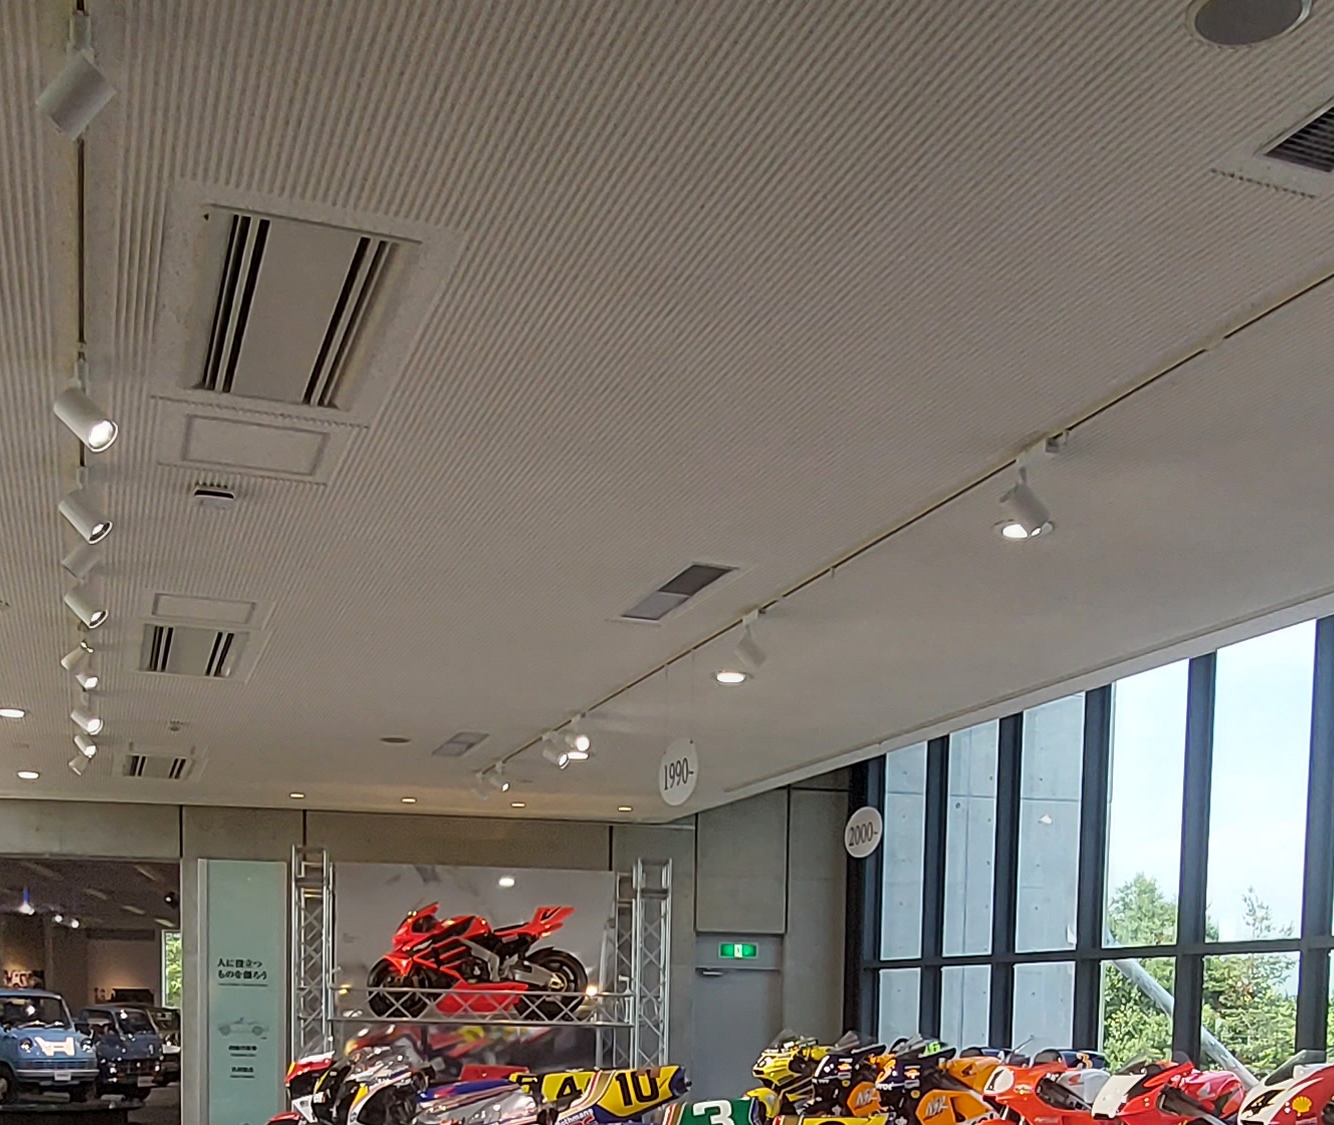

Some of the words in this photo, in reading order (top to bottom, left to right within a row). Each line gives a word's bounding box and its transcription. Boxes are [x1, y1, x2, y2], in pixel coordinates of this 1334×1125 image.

[556, 1076, 584, 1100] 4
[615, 1069, 660, 1107] 10
[1241, 1089, 1286, 1118] 4
